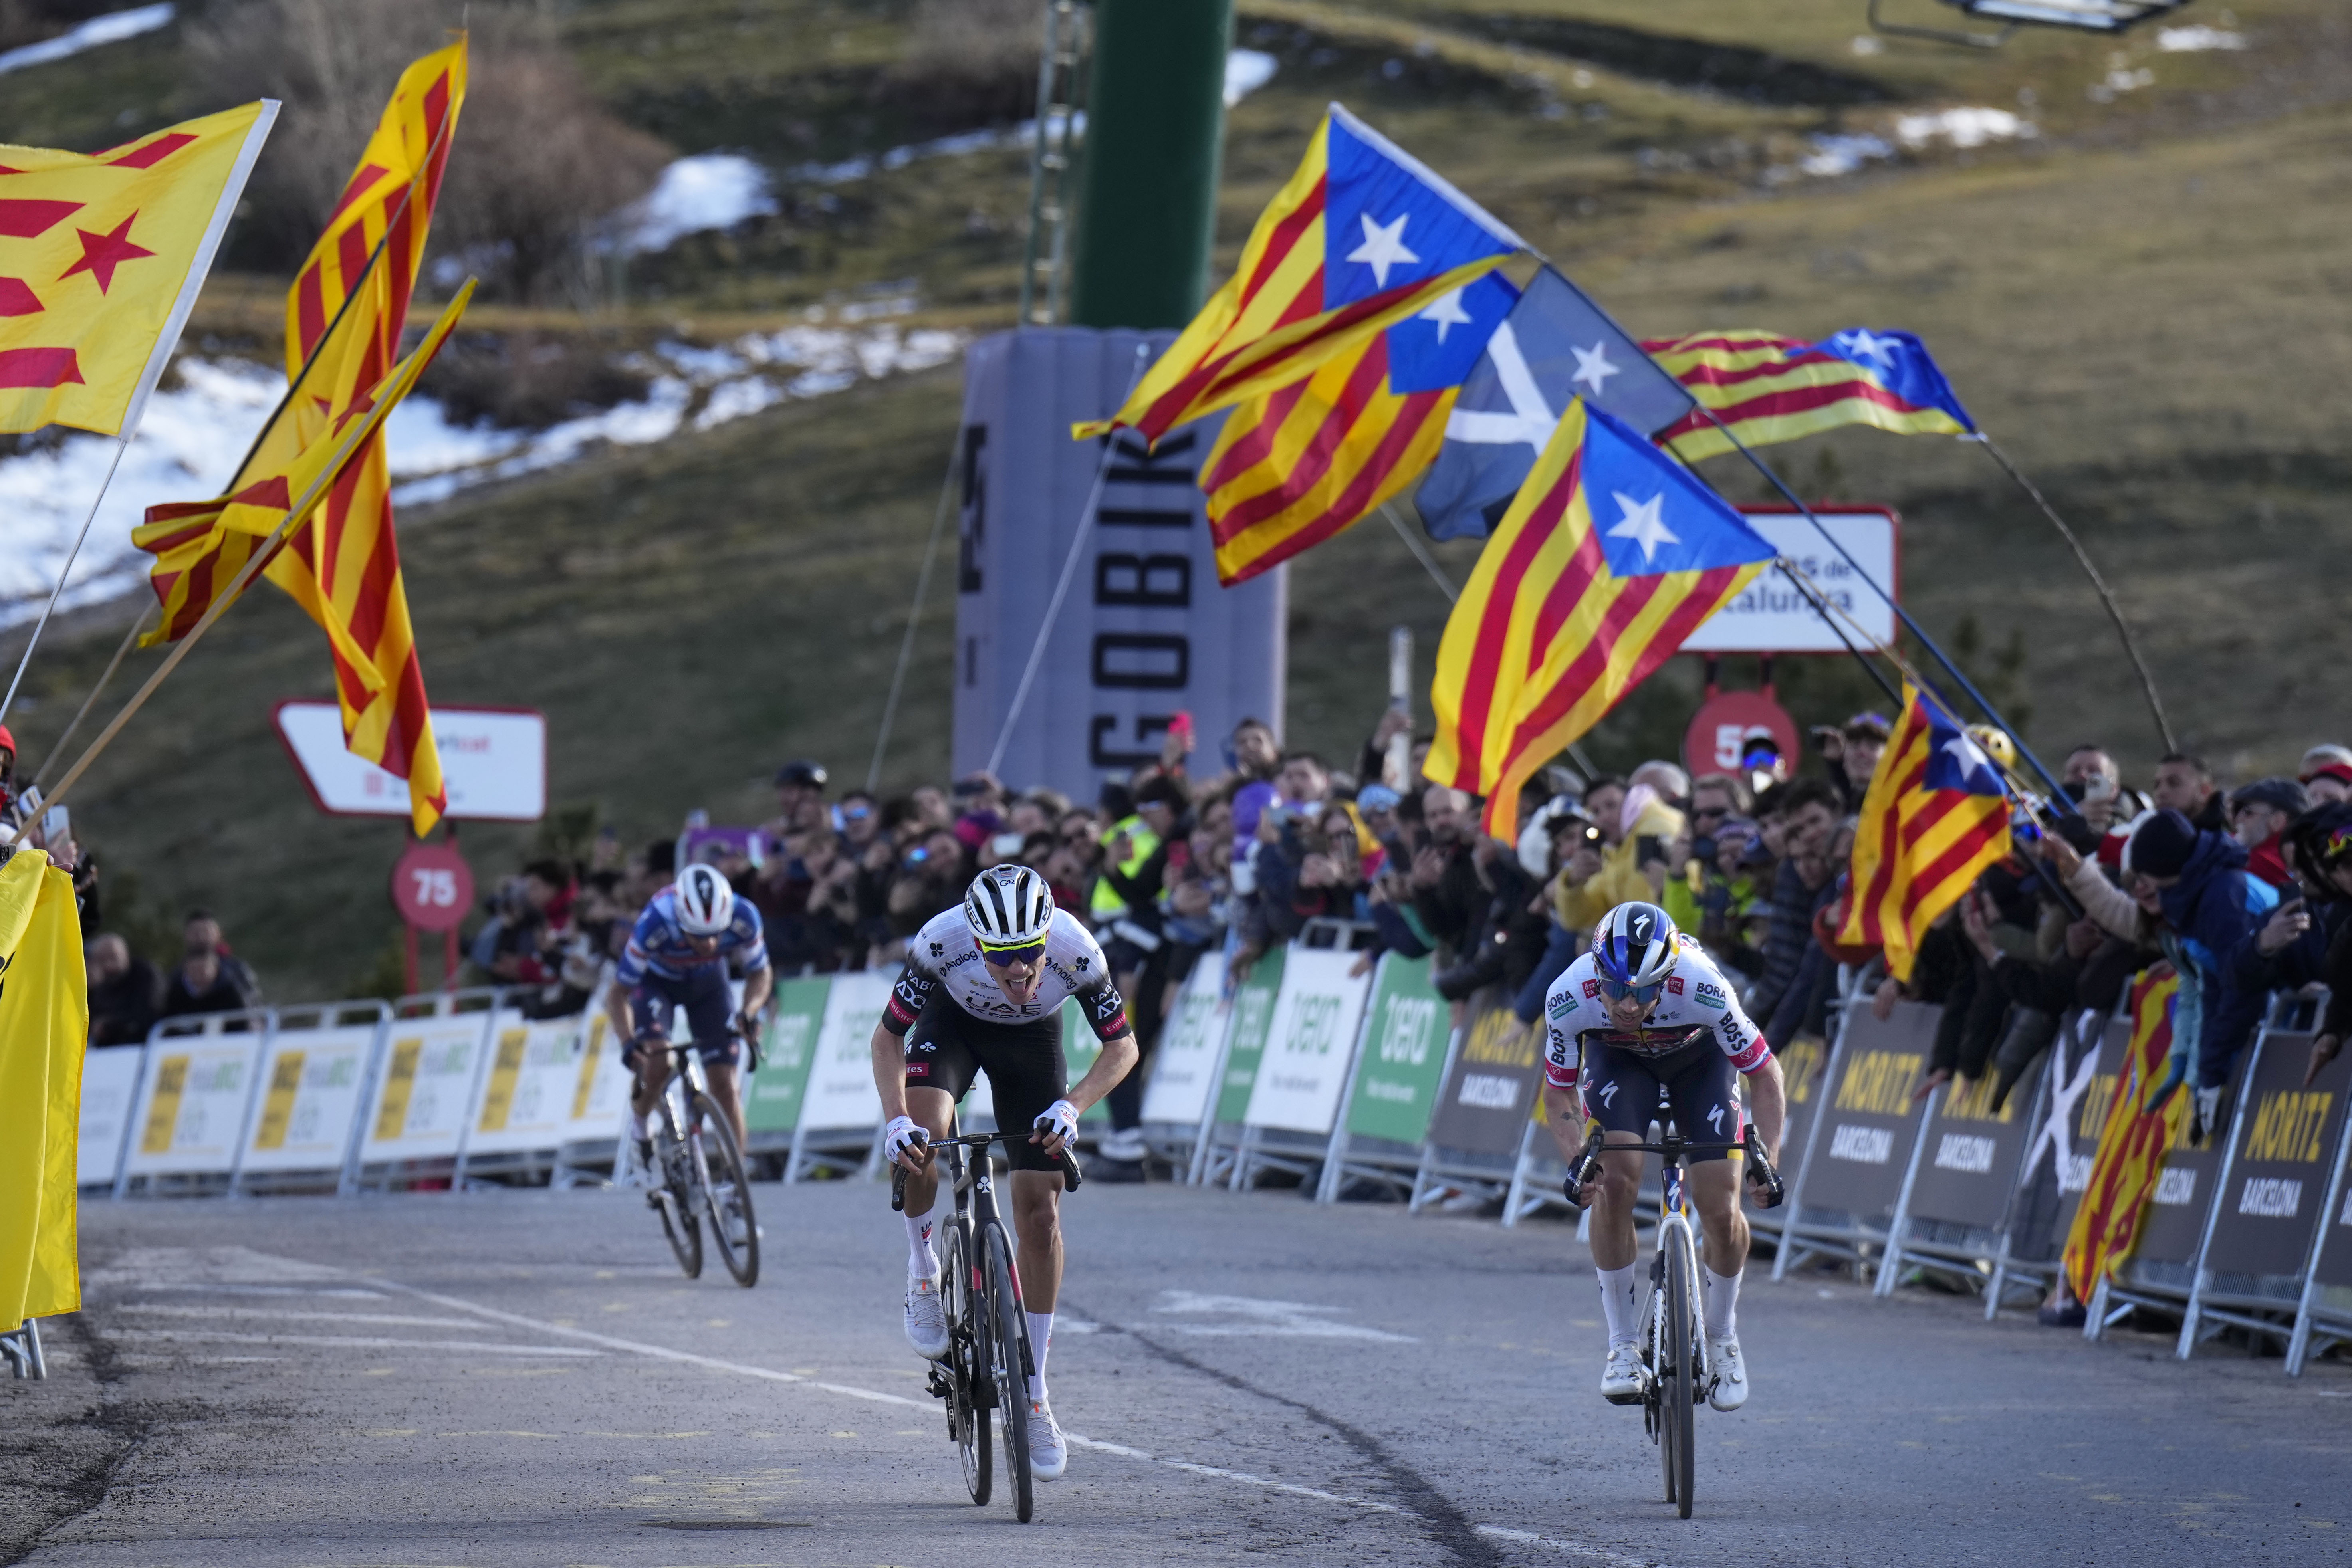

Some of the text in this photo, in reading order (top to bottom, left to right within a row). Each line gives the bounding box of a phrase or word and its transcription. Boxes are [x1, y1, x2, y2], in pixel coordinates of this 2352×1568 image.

[1089, 432, 1195, 767] GOBIK
[412, 869, 457, 906] 75
[944, 950, 978, 971] Analog
[1049, 962, 1078, 990] Analog
[1547, 990, 1574, 1012] BORA
[1695, 994, 1725, 1008] hansgrohe
[1696, 982, 1726, 1000] BORA
[1551, 1002, 1577, 1019] hansgrohe
[1549, 1024, 1565, 1066] BOSS
[1718, 1011, 1748, 1051] BOSS
[1834, 1049, 1923, 1117] MORITZ
[1828, 1123, 1895, 1165] BARCELONA
[2244, 1090, 2334, 1162] MORITZ
[2239, 1177, 2303, 1218] BARCELONA
